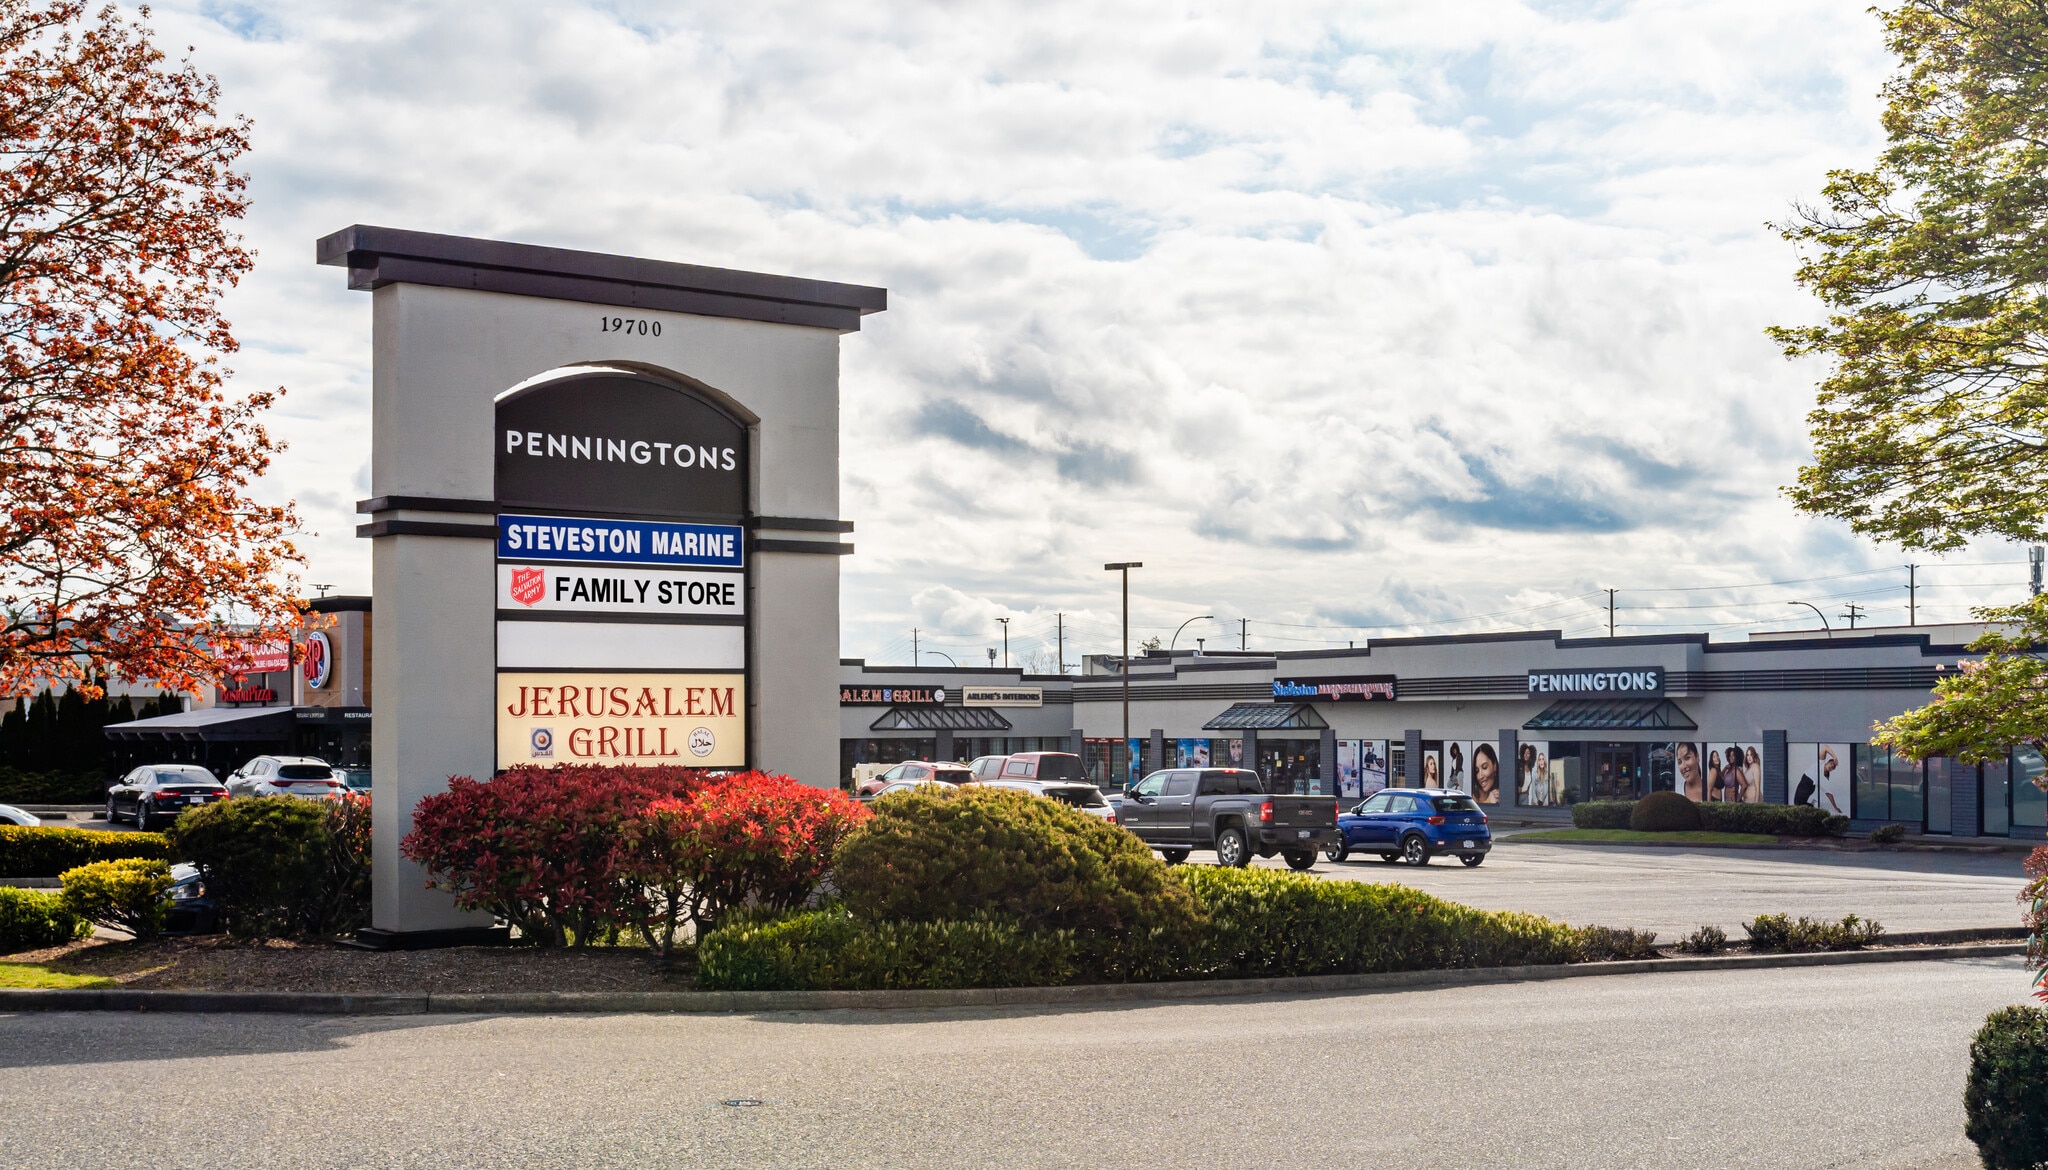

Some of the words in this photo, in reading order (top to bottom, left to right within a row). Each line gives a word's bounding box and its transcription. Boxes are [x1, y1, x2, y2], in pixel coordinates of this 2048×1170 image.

[602, 316, 662, 337] 19700
[506, 430, 736, 471] PENNINGTONS
[508, 524, 641, 554] STEVESTON
[652, 531, 734, 557] MARINE
[512, 573, 542, 597] SALVATION
[517, 571, 530, 584] THE
[523, 583, 541, 602] ARMY
[556, 577, 651, 603] FAMILY
[658, 581, 735, 606] STORE
[1529, 672, 1658, 692] PENNINGTONS
[249, 685, 272, 701] Pizza
[507, 685, 737, 718] JERUSALEM
[840, 689, 882, 702] ALEM
[893, 689, 934, 703] GRILL
[1003, 693, 1040, 701] INTERIORS
[568, 726, 682, 758] GRILL
[692, 739, 712, 748] حلال
